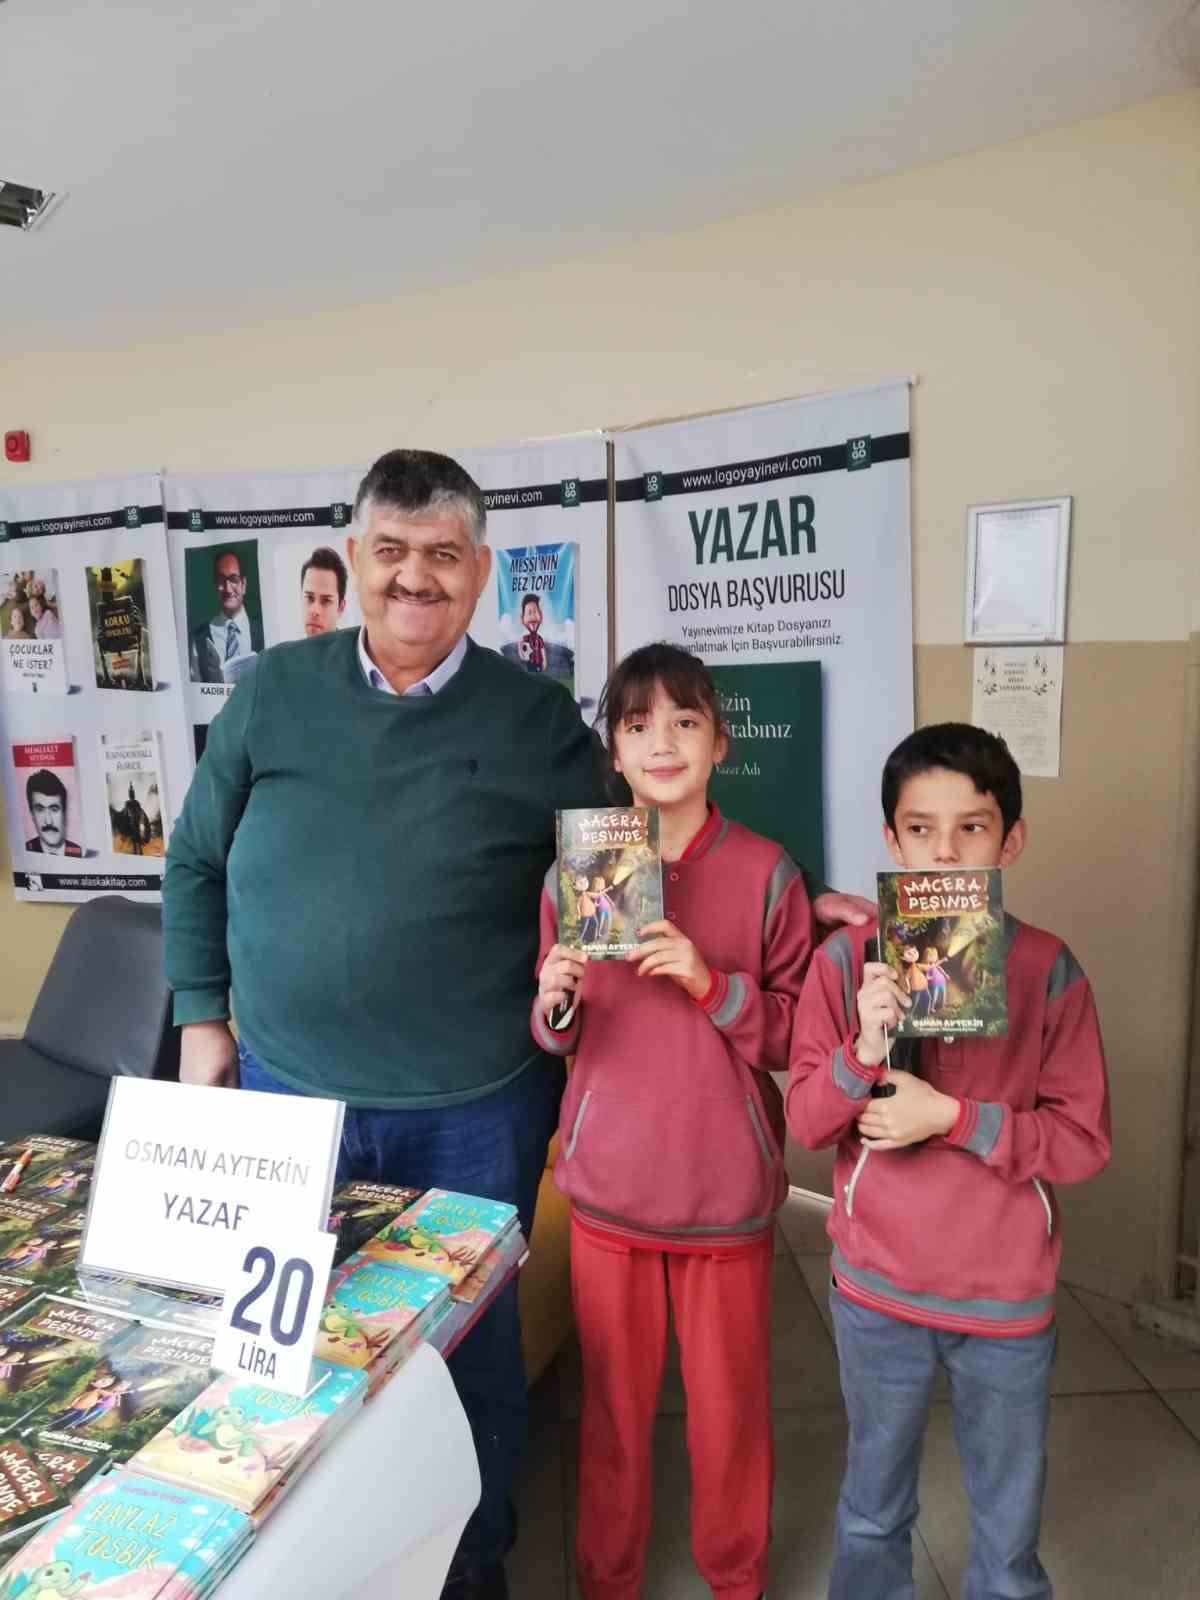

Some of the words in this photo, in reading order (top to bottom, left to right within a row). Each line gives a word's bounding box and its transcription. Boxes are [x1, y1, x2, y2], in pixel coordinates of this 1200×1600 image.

[682, 453, 822, 488] www.logoyayinevi.com
[484, 491, 543, 508] ayinevi.com
[688, 495, 817, 565] YAZAR
[512, 576, 528, 592] BEZ
[531, 574, 556, 592] TOPU
[668, 581, 722, 612] DOSYA
[727, 569, 845, 611] BAŞVURUSU
[720, 692, 751, 711] izin
[726, 715, 792, 738] itabınız
[578, 814, 642, 831] MACERA
[904, 876, 981, 896] MACERA
[125, 1139, 207, 1171] OSMAN
[211, 1156, 309, 1186] AYTEKİN
[230, 1246, 314, 1346] 20
[48, 1309, 116, 1331] MACERA
[151, 1336, 213, 1354] MACER
[238, 1341, 277, 1379] LİRA
